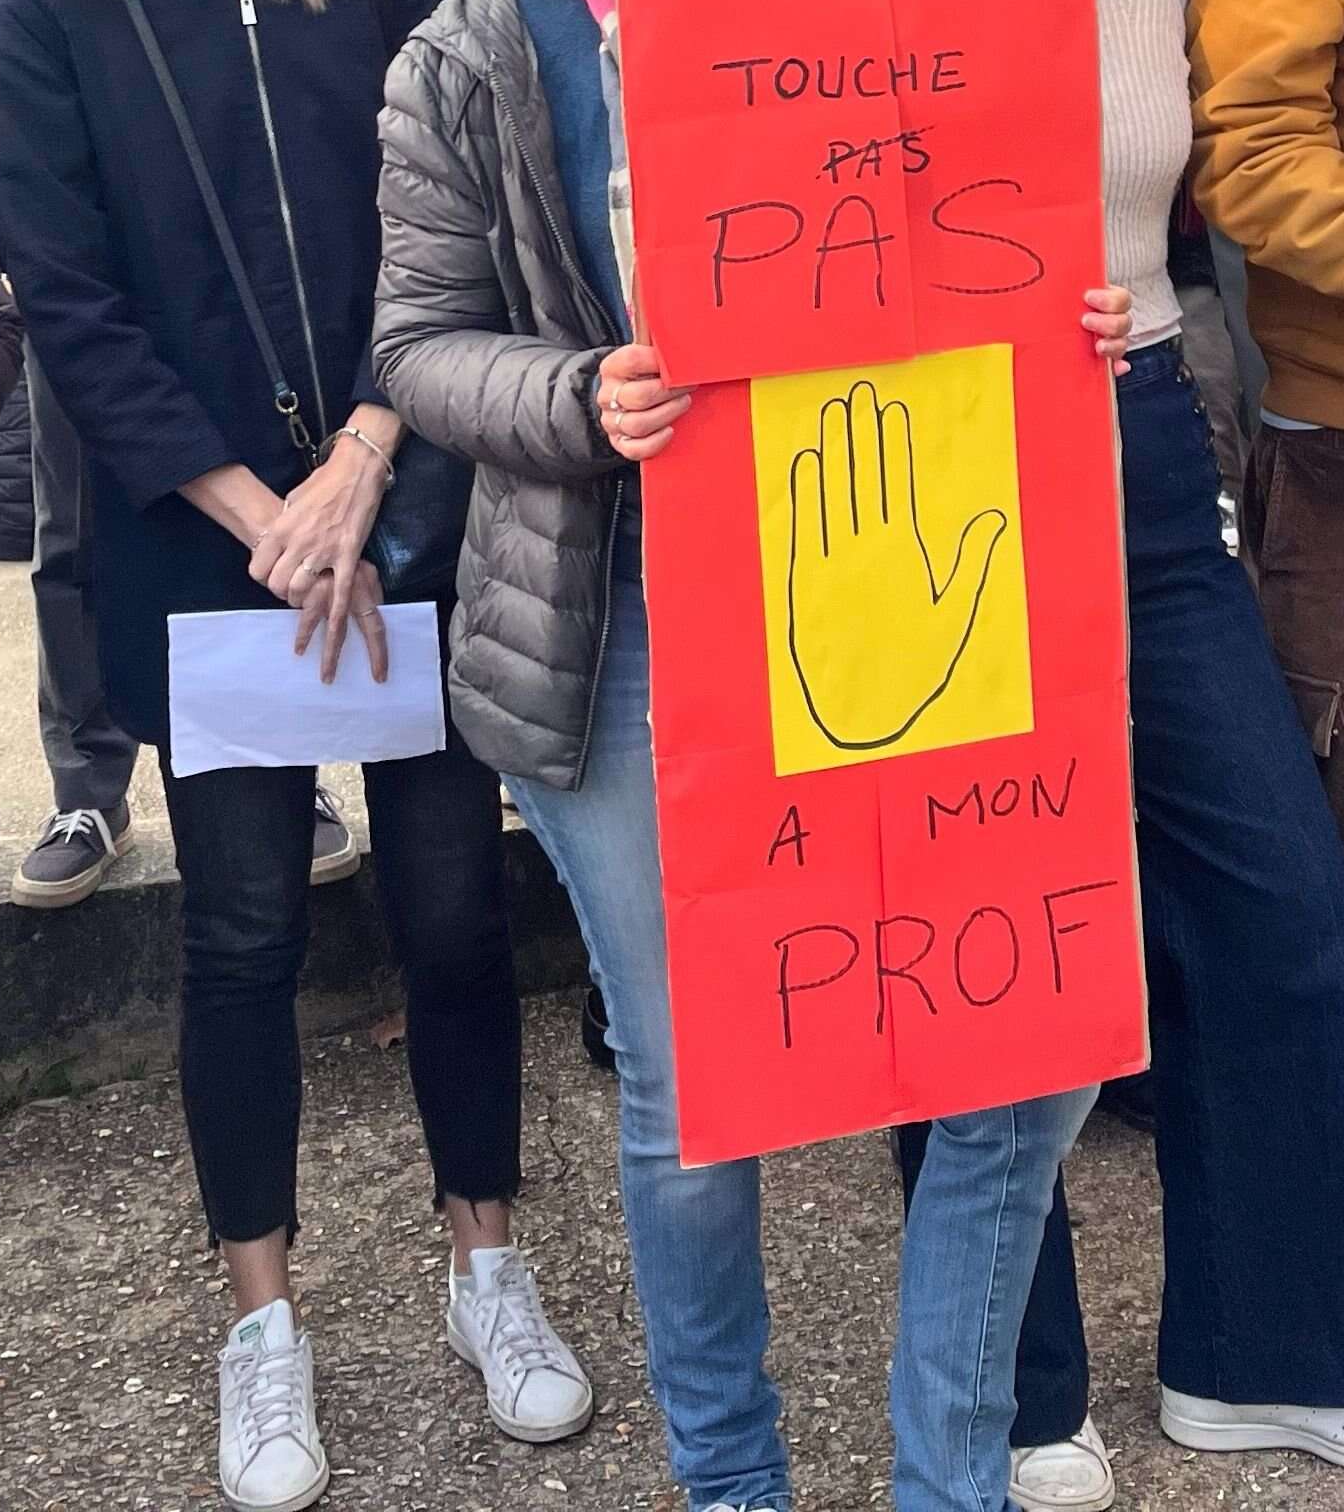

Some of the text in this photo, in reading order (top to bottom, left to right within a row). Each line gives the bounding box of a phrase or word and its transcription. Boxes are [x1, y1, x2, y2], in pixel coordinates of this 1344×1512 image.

[712, 49, 967, 107] TOUCHE
[707, 179, 1045, 309] PAS
[766, 757, 1077, 867] A MON
[775, 878, 1119, 1048] PROF
